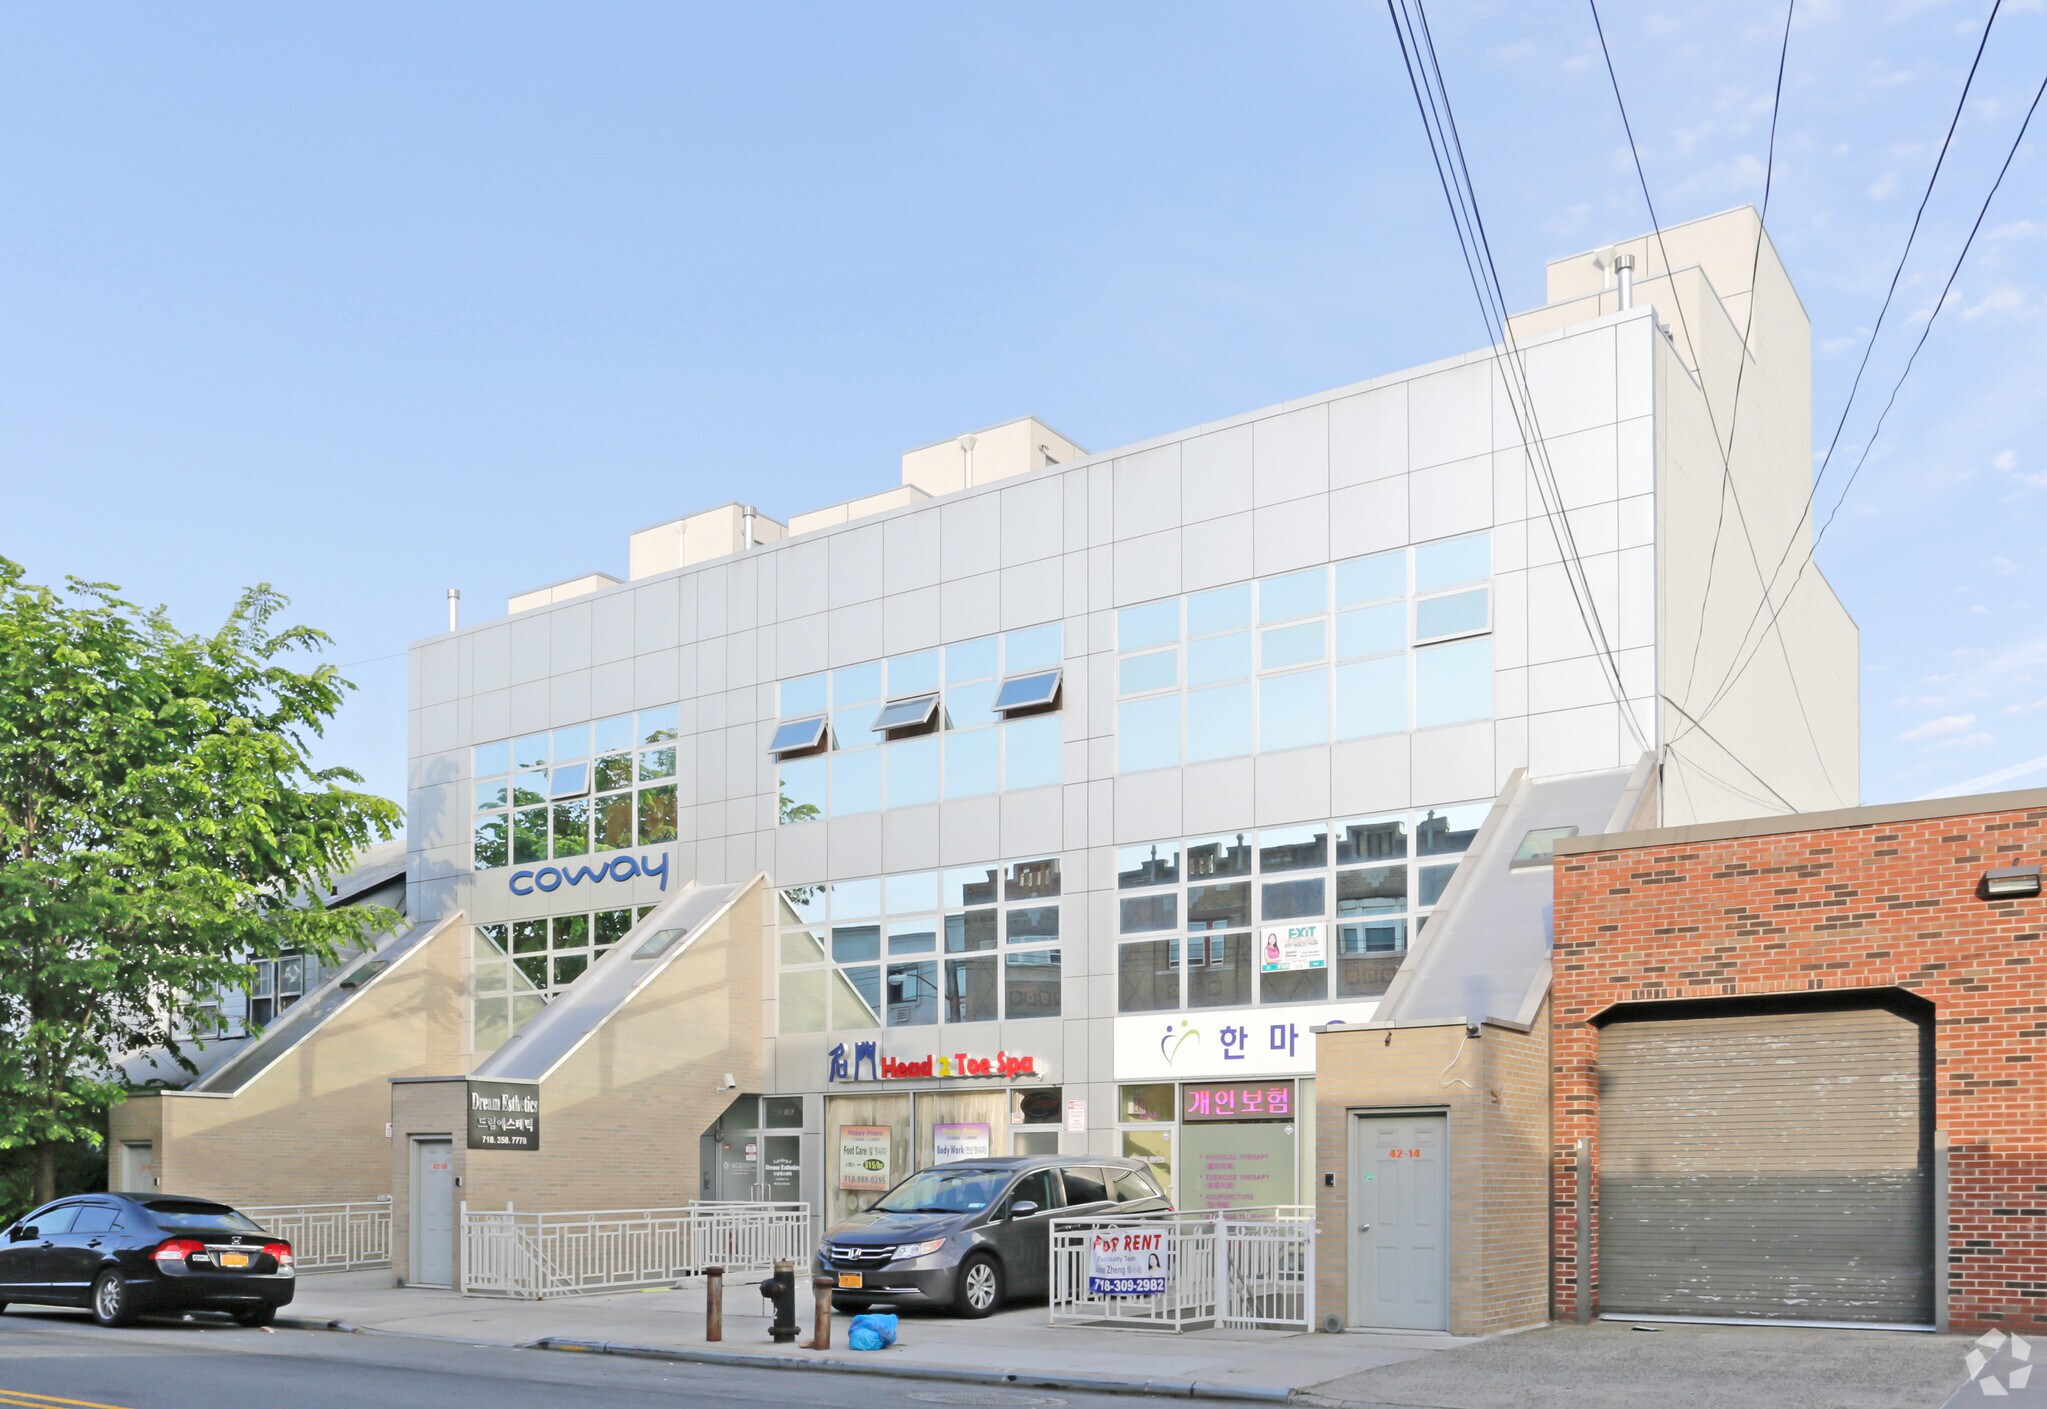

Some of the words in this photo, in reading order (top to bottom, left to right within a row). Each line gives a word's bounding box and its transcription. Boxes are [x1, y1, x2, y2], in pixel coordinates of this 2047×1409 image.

[509, 852, 669, 895] coway
[881, 1054, 932, 1078] Head
[938, 1056, 951, 1076] 2
[955, 1053, 991, 1075] Toe
[997, 1050, 1034, 1078] Spa
[471, 1092, 500, 1111] Dream
[1188, 1088, 1288, 1115] 개인보험
[843, 1145, 855, 1155] Foot
[855, 1145, 867, 1155] Care
[937, 1145, 950, 1157] Body
[950, 1145, 964, 1154] Work
[1389, 1149, 1420, 1158] 42-14
[1124, 1234, 1161, 1251] RENT
[1106, 1265, 1125, 1276] Zheng
[1094, 1279, 1164, 1291] 718-309-2982
